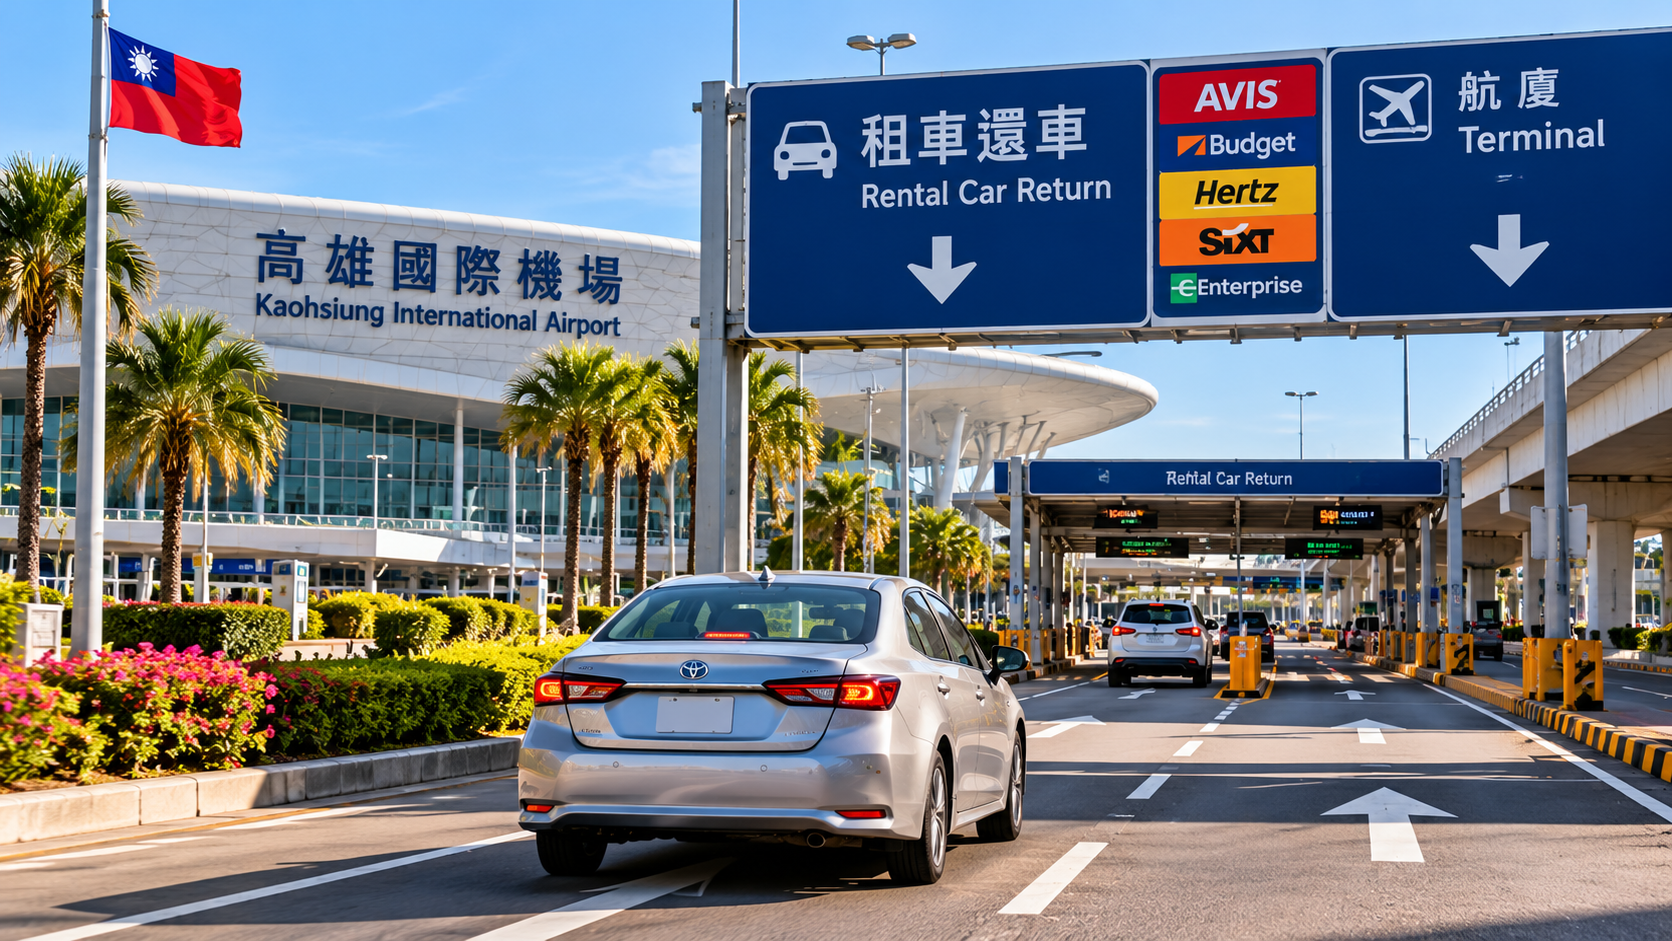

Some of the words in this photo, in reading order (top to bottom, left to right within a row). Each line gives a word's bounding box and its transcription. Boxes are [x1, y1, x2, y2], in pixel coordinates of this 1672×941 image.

[1194, 79, 1279, 112] AVIS
[1458, 67, 1560, 112] 航廈
[861, 104, 1087, 168] 租車還車
[1210, 132, 1296, 160] Budget
[1458, 119, 1605, 154] Terminal
[862, 180, 949, 208] Rental
[958, 179, 1007, 206] Car
[1018, 177, 1112, 203] Return
[1194, 179, 1279, 205] Hertz
[256, 228, 623, 305] 高雄國際機場
[1198, 275, 1303, 299] Enterprise
[256, 293, 385, 328] Kaohsiung
[394, 302, 537, 332] International
[545, 311, 621, 340] Airport
[1216, 471, 1241, 485] Car
[1245, 471, 1293, 486] Return
